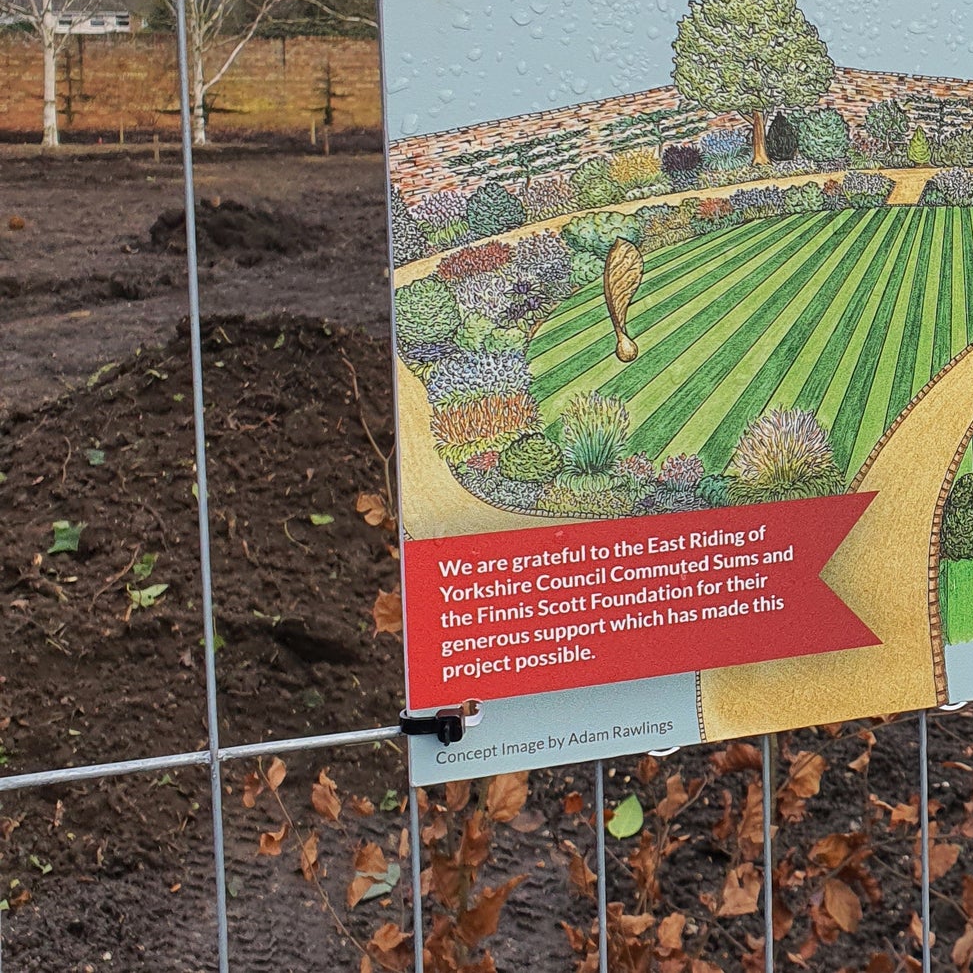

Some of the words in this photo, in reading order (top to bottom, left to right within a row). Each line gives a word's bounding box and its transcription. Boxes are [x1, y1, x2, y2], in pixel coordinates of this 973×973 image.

[438, 559, 472, 577] We
[477, 559, 508, 573] are
[512, 545, 586, 572] grateful
[590, 545, 609, 560] to
[614, 541, 643, 556] the
[648, 536, 686, 554] East
[690, 530, 744, 548] Riding
[748, 525, 766, 541] of
[439, 579, 532, 603] Yorkshire
[536, 568, 606, 591] Council
[610, 555, 709, 582] Commuted
[713, 553, 758, 570] Sums
[763, 545, 794, 562] and
[440, 610, 472, 628] the
[477, 602, 533, 624] Finnis
[538, 597, 586, 616] Scott
[591, 584, 693, 609] Foundation
[697, 579, 723, 596] for
[726, 573, 768, 592] their
[442, 631, 529, 657] generous
[534, 619, 606, 642] support
[610, 610, 663, 632] which
[668, 608, 698, 624] has
[702, 600, 749, 619] made
[753, 595, 784, 613] this
[442, 656, 511, 682] project
[515, 645, 596, 672] possible.
[436, 746, 497, 765] Concept
[502, 737, 544, 756] Image
[548, 736, 565, 751] by
[568, 729, 609, 746] Adam
[613, 720, 674, 739] Rawlings
